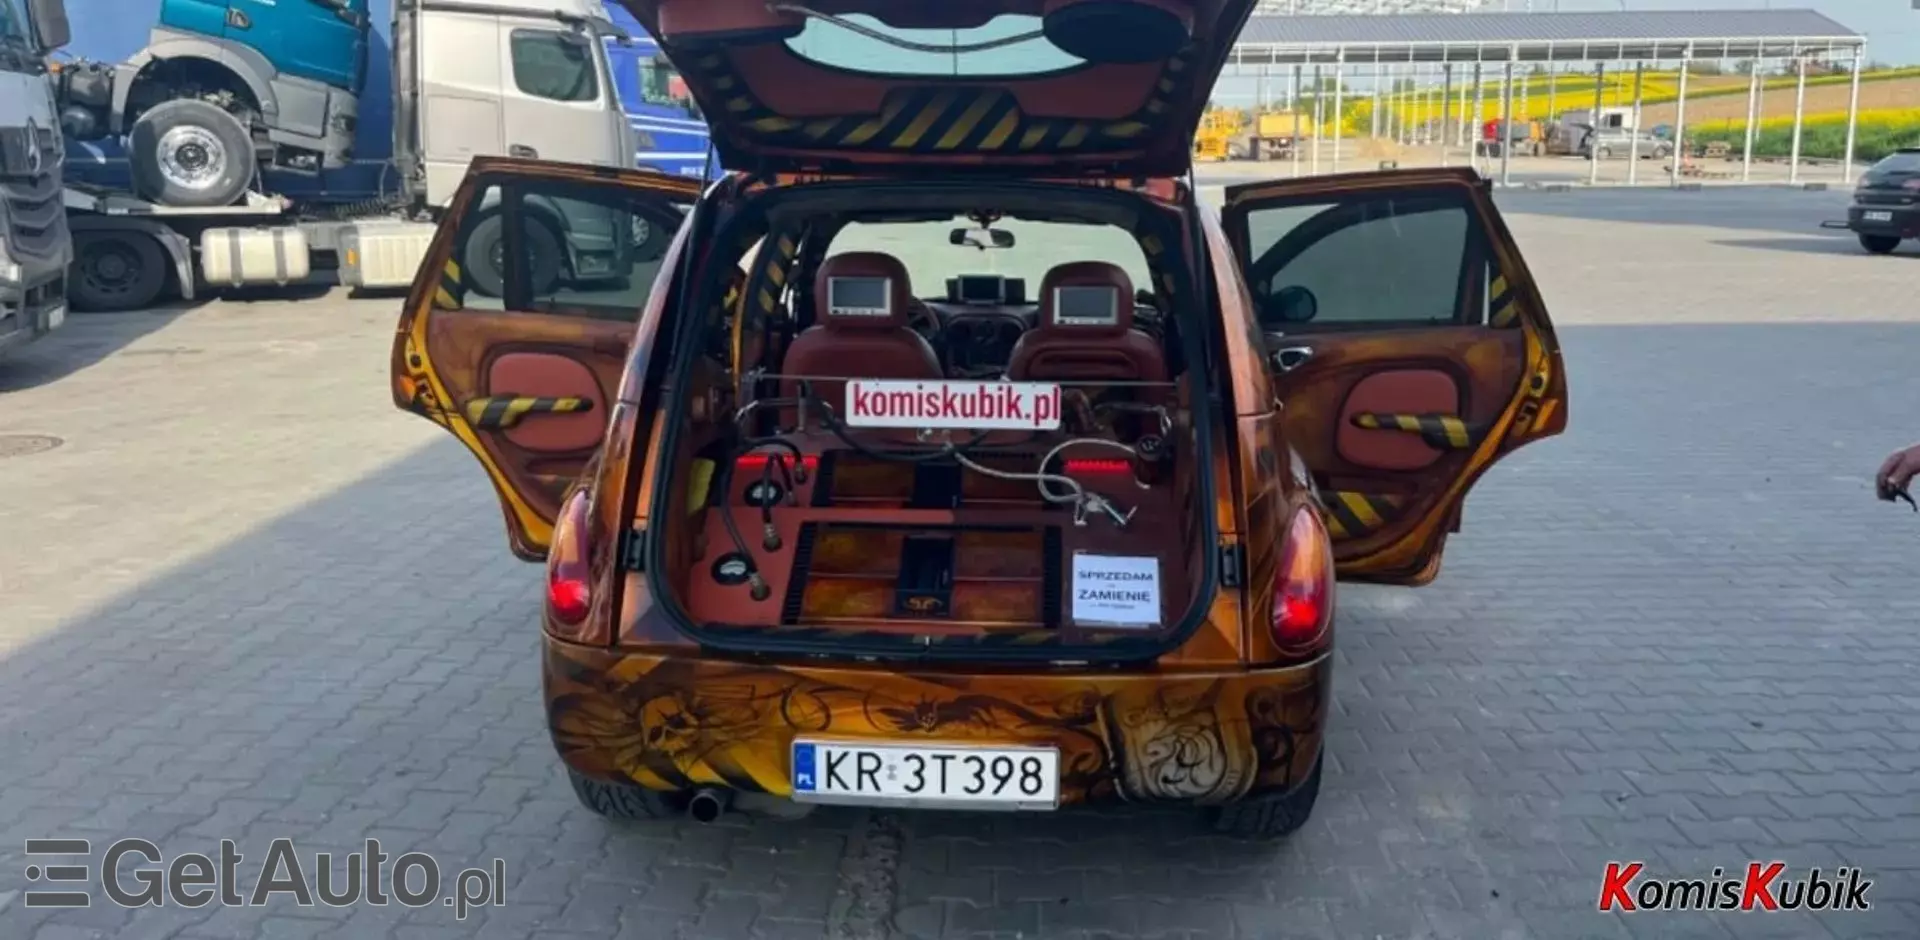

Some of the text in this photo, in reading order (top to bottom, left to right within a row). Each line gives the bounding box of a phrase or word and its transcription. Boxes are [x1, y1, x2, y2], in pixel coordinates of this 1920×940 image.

[853, 383, 1059, 427] komiskubik.pl
[1078, 570, 1154, 582] SPRZEDAM
[1078, 589, 1151, 603] ZAMIENIĘ
[825, 750, 1043, 795] KR 3T398
